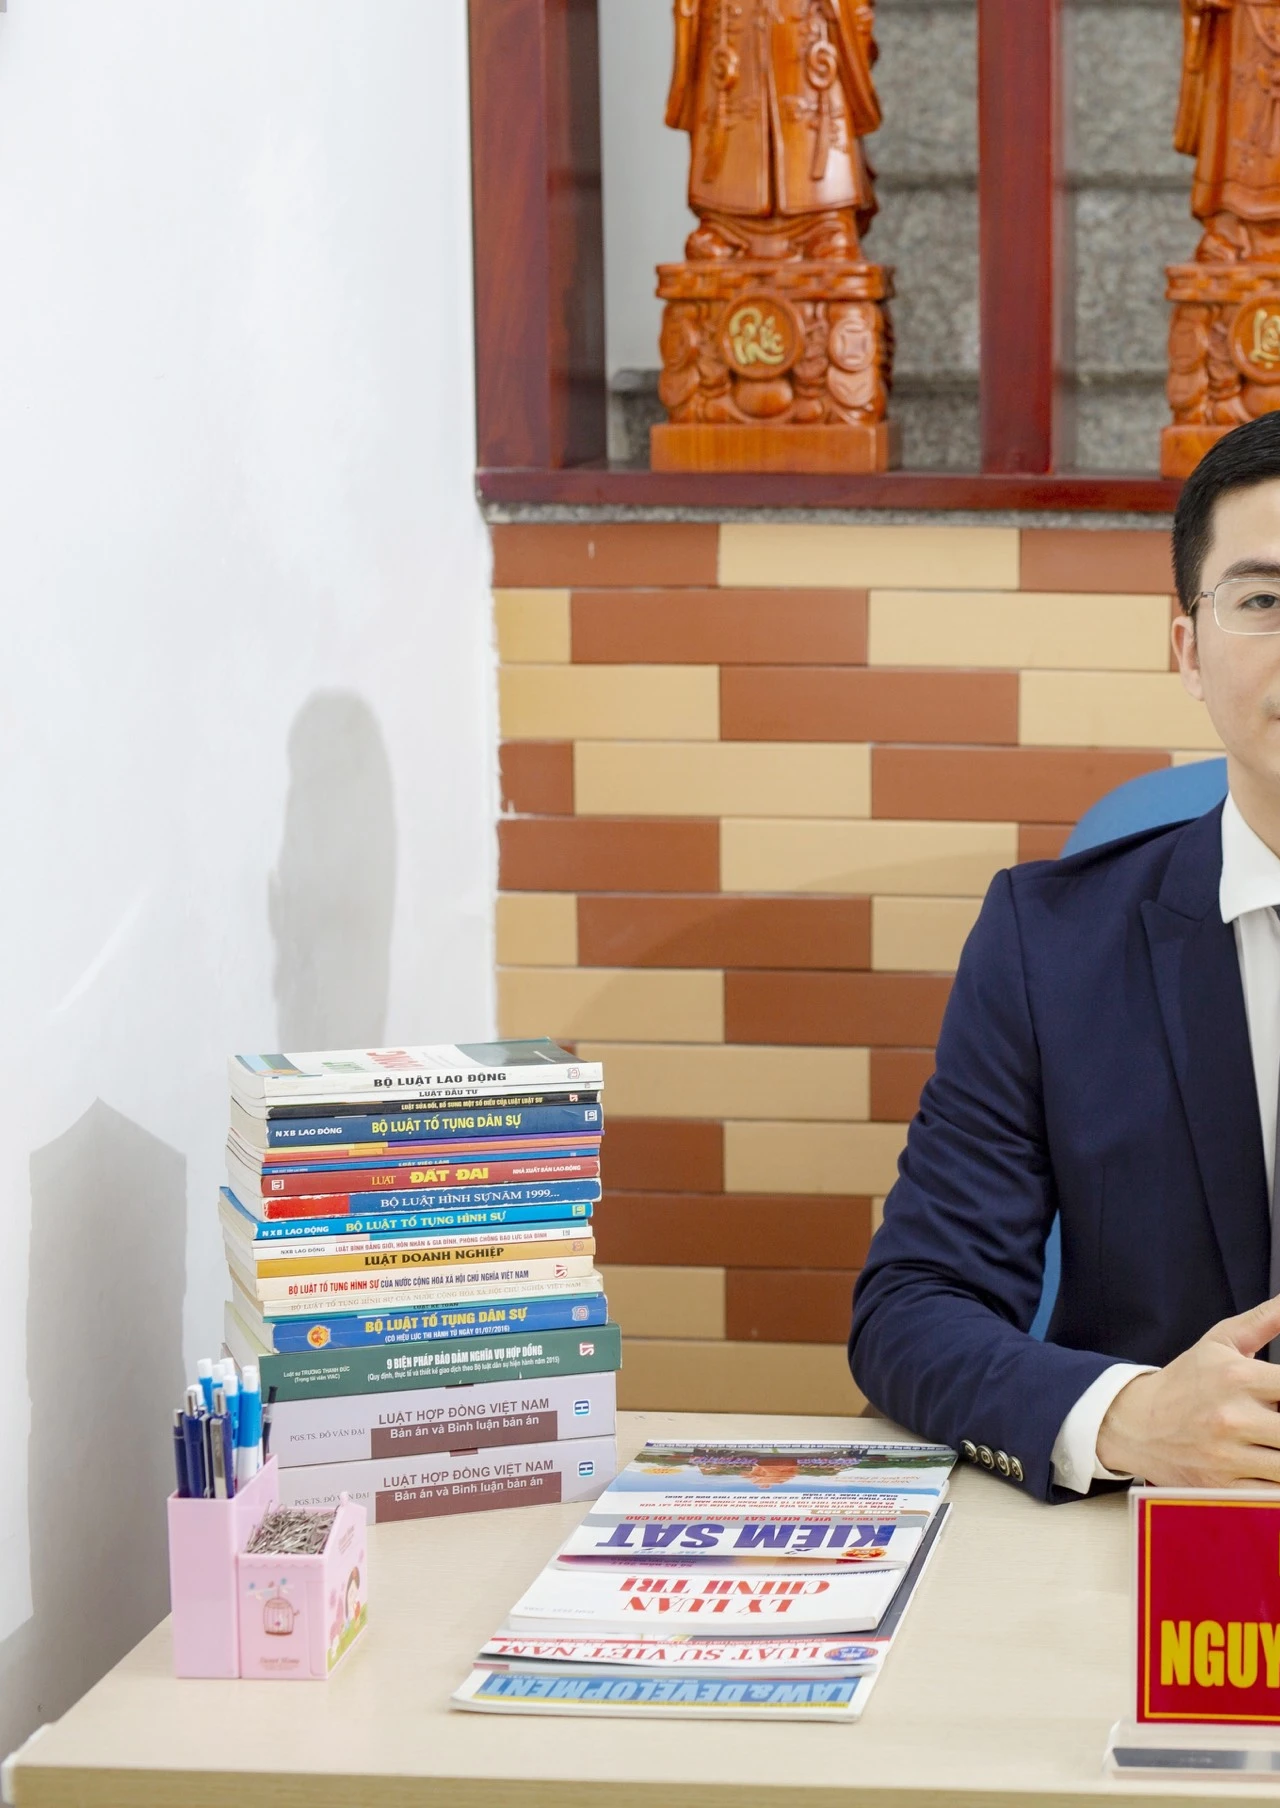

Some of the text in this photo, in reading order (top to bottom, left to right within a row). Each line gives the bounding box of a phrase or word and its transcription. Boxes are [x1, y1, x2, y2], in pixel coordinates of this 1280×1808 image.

[374, 1073, 506, 1089] BỘ LUẬT LAO ĐỘNG
[372, 1115, 522, 1135] BỘ LUẬT TỐ TỤNG DÂN SỰ
[410, 1167, 450, 1183] ĐẤT
[456, 1168, 489, 1181] ĐAI
[304, 1226, 329, 1235] ĐỘNG
[346, 1213, 506, 1233] BỘ LUẬT TỐ TỤNG HÌNH SỰ
[365, 1248, 504, 1266] LUẬT DOANH NGHIỆP
[366, 1309, 528, 1334] BỘ LUẬT TỐ TỤNG DÂN SỰ
[387, 1343, 543, 1371] 9 BIỆN PHÁP BẢO ĐẢM NGHĨA VỤ HỢP ĐỒNG
[379, 1399, 549, 1425] LUẬT HỢP ĐỒNG VIỆT NAM
[391, 1416, 539, 1438] Bản án và Bình luận bản án
[384, 1460, 553, 1488] LUẬT HỢP ĐỒNG VIỆT NAM
[395, 1477, 543, 1501] Bản án và Bình luận bản án
[595, 1523, 896, 1555] KIỂM SÁT
[618, 1575, 830, 1597] CHÍNH TRỊ
[620, 1595, 796, 1616] LÝ LUẬN
[496, 1645, 577, 1658] NAM
[676, 1648, 724, 1663] SƯ
[482, 1679, 857, 1702] LAW&DEVELOPMENT
